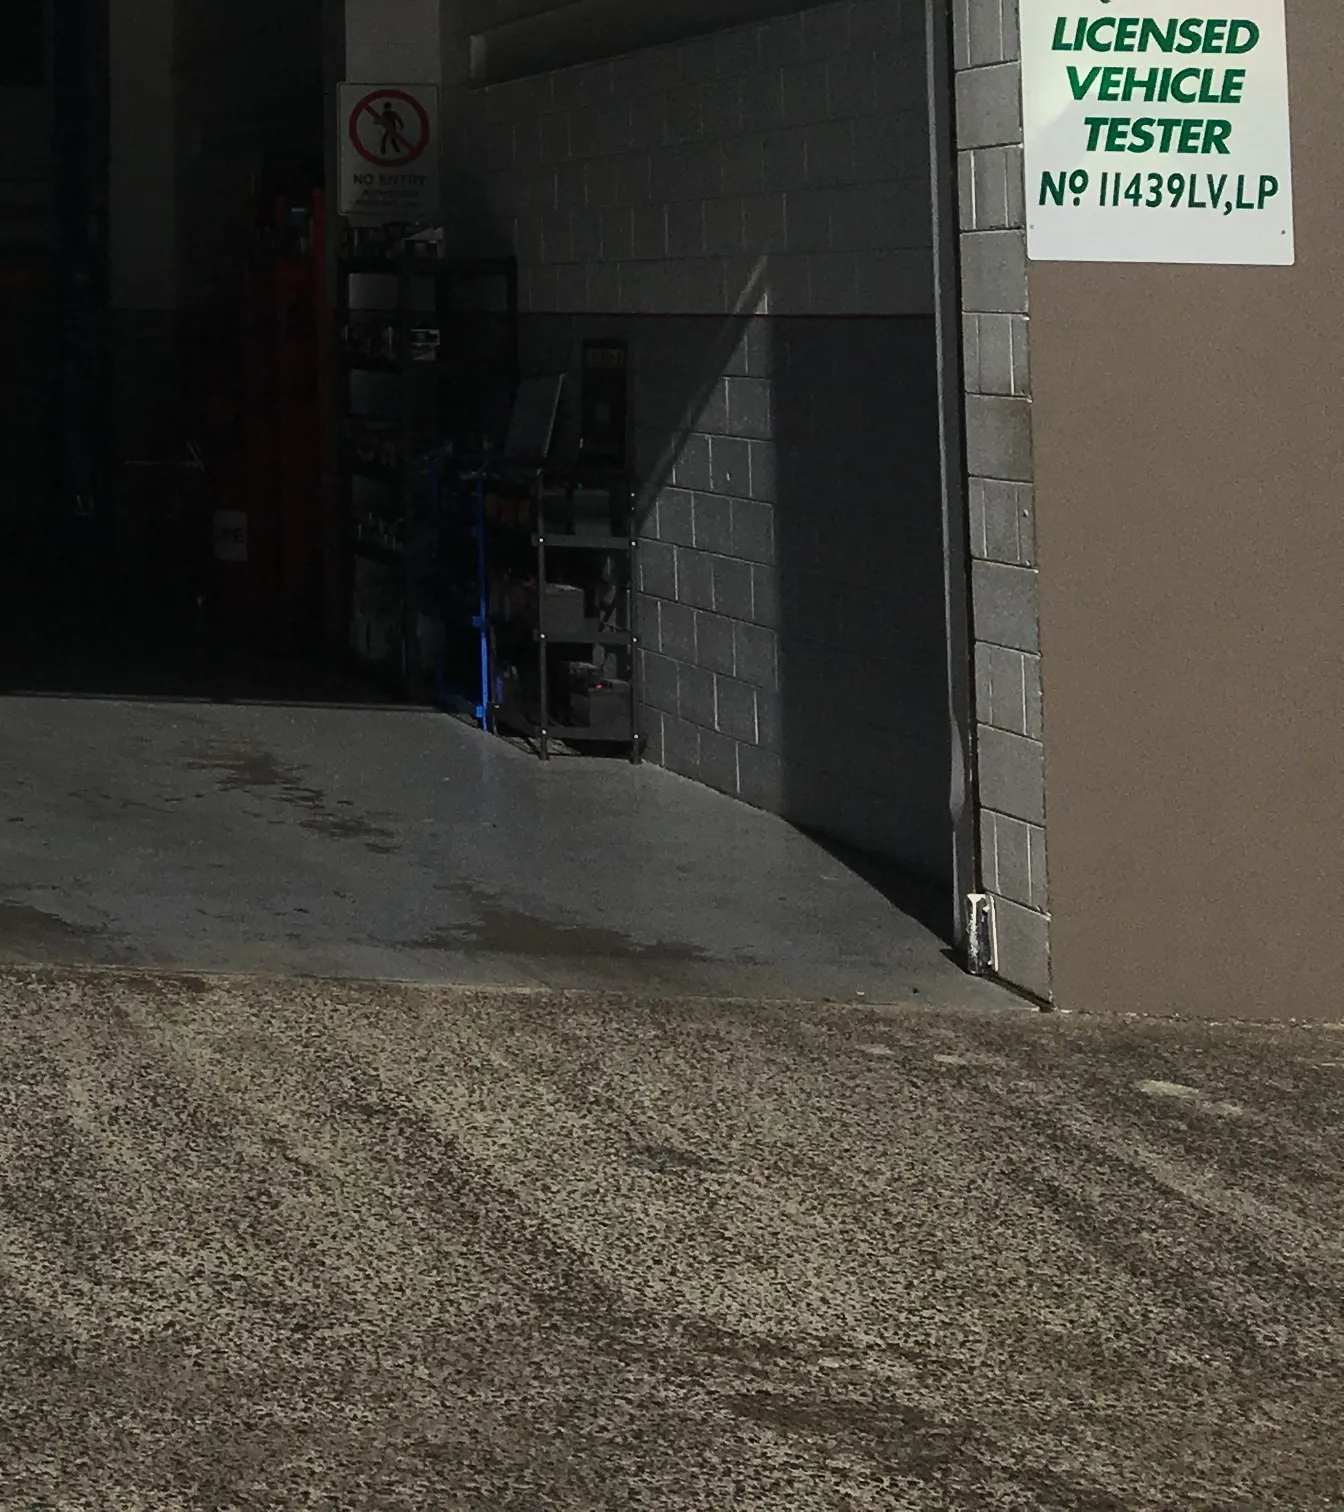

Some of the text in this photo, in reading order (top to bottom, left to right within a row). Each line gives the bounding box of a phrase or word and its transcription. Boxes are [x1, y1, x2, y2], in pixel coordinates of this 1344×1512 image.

[1051, 17, 1259, 54] LICENSED
[1066, 66, 1246, 103] VEHICLE
[1084, 117, 1231, 154] TESTER
